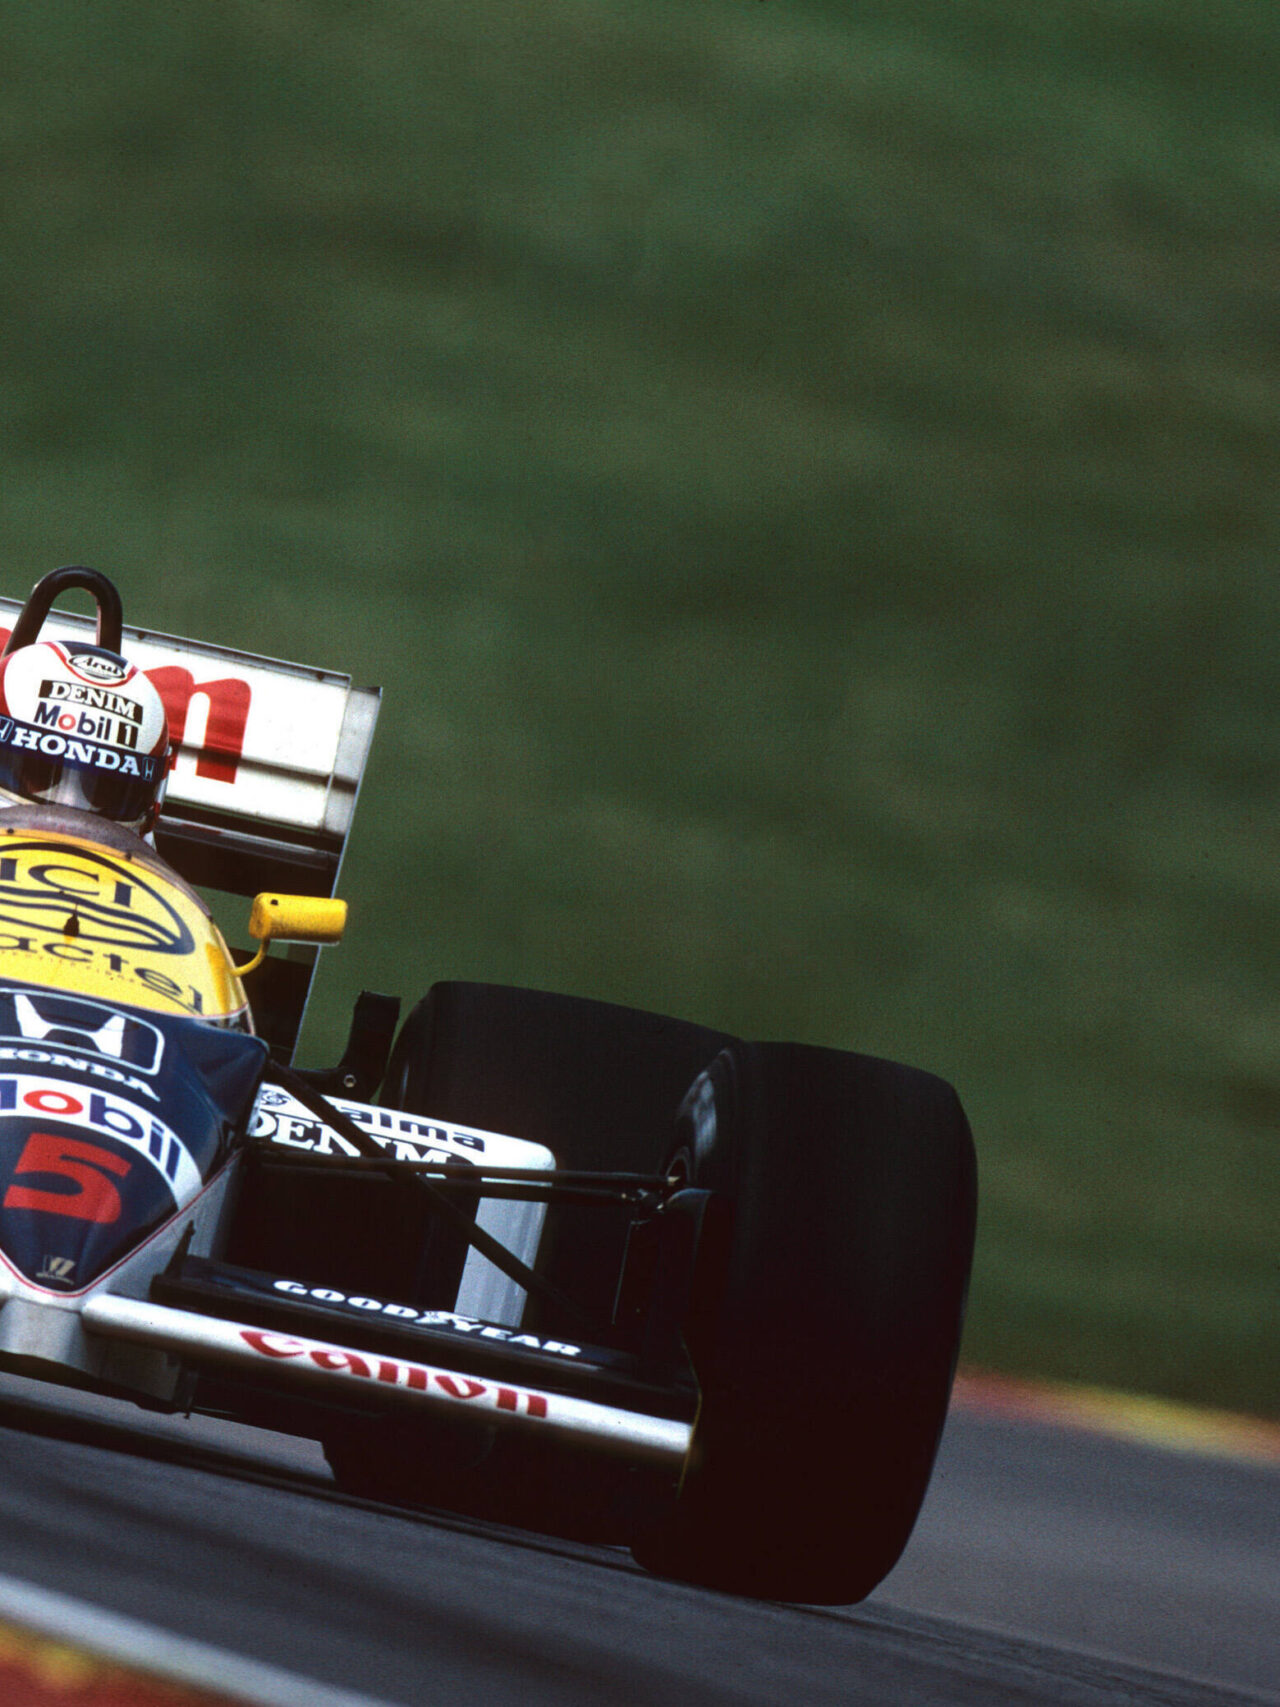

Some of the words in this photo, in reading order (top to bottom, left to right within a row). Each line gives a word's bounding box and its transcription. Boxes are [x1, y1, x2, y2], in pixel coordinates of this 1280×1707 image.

[33, 701, 113, 741] Mobil
[48, 681, 136, 719] DENIM
[10, 727, 141, 777] HONDA
[248, 1109, 452, 1179] DENM
[332, 1104, 486, 1153] alma
[2, 1131, 133, 1225] 5
[273, 1280, 584, 1357] GOODYEAR
[239, 1329, 548, 1419] Canon
